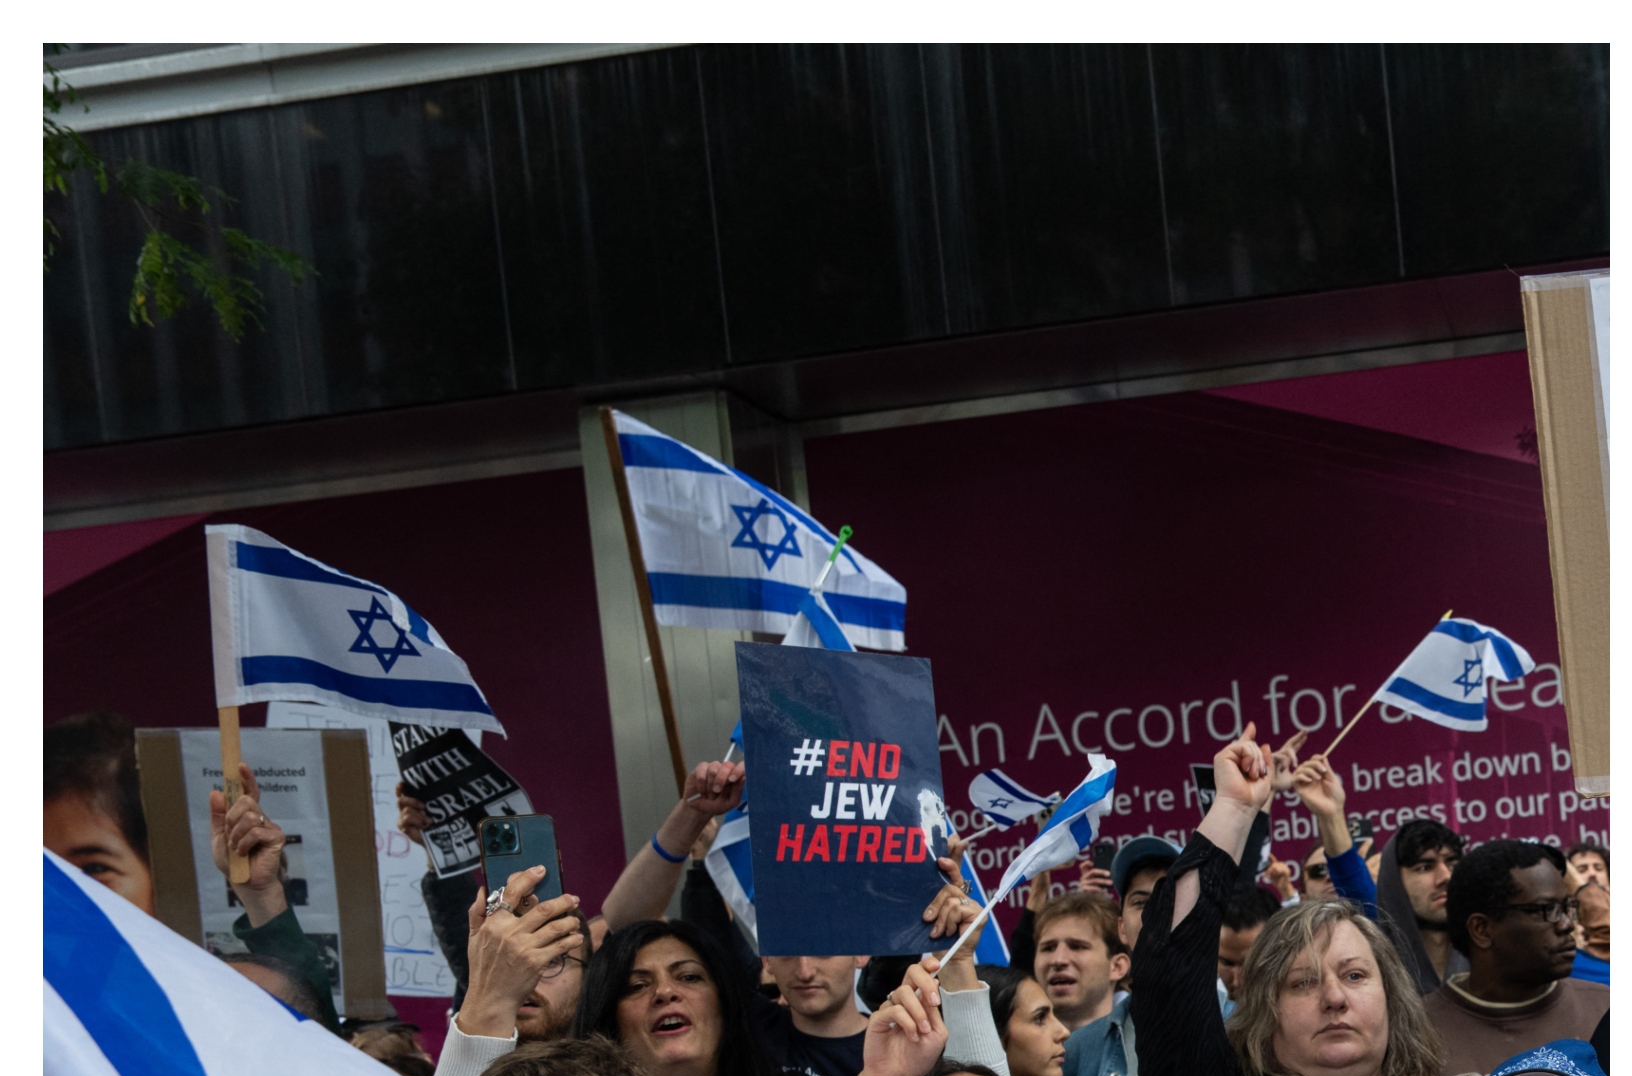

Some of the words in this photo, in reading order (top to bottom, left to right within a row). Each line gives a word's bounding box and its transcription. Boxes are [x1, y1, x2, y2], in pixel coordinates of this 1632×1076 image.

[938, 714, 1007, 767] An
[1028, 680, 1242, 760] Accord
[1262, 674, 1357, 736] for
[254, 766, 306, 778] abducted
[402, 747, 473, 790] WITH
[790, 737, 902, 780] #END
[259, 781, 298, 793] hildren
[426, 773, 512, 824] SRAEL
[810, 782, 897, 820] JEW
[1113, 785, 1175, 815] e're
[1352, 755, 1444, 792] break
[1452, 751, 1542, 782] down
[1454, 797, 1487, 823] to
[1495, 792, 1551, 819] our
[775, 823, 928, 863] HATRED
